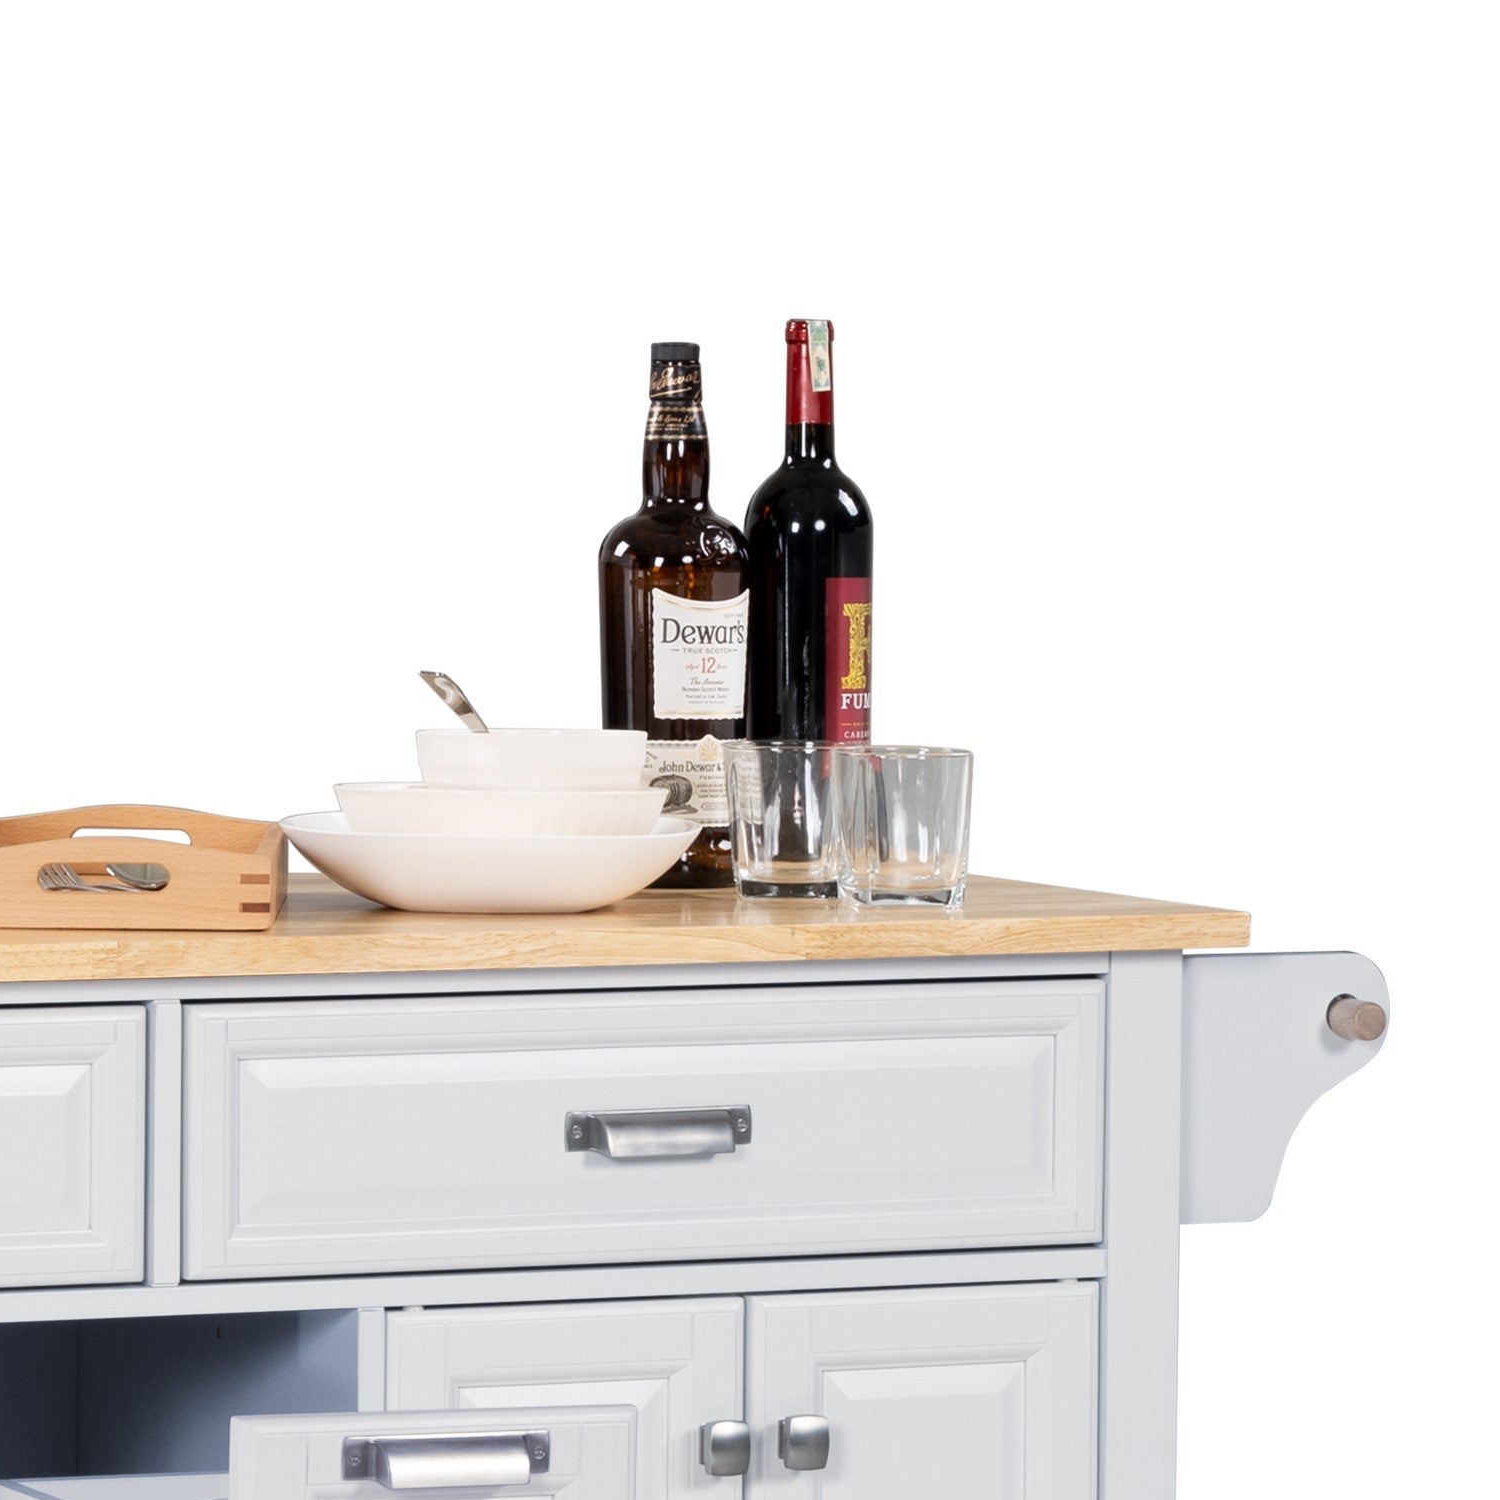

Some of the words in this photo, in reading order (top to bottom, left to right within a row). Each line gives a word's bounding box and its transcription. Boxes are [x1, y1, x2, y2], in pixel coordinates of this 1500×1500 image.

[661, 617, 745, 645] Dewar's
[701, 656, 716, 674] 12
[659, 761, 684, 773] John
[686, 760, 716, 773] Dewar
